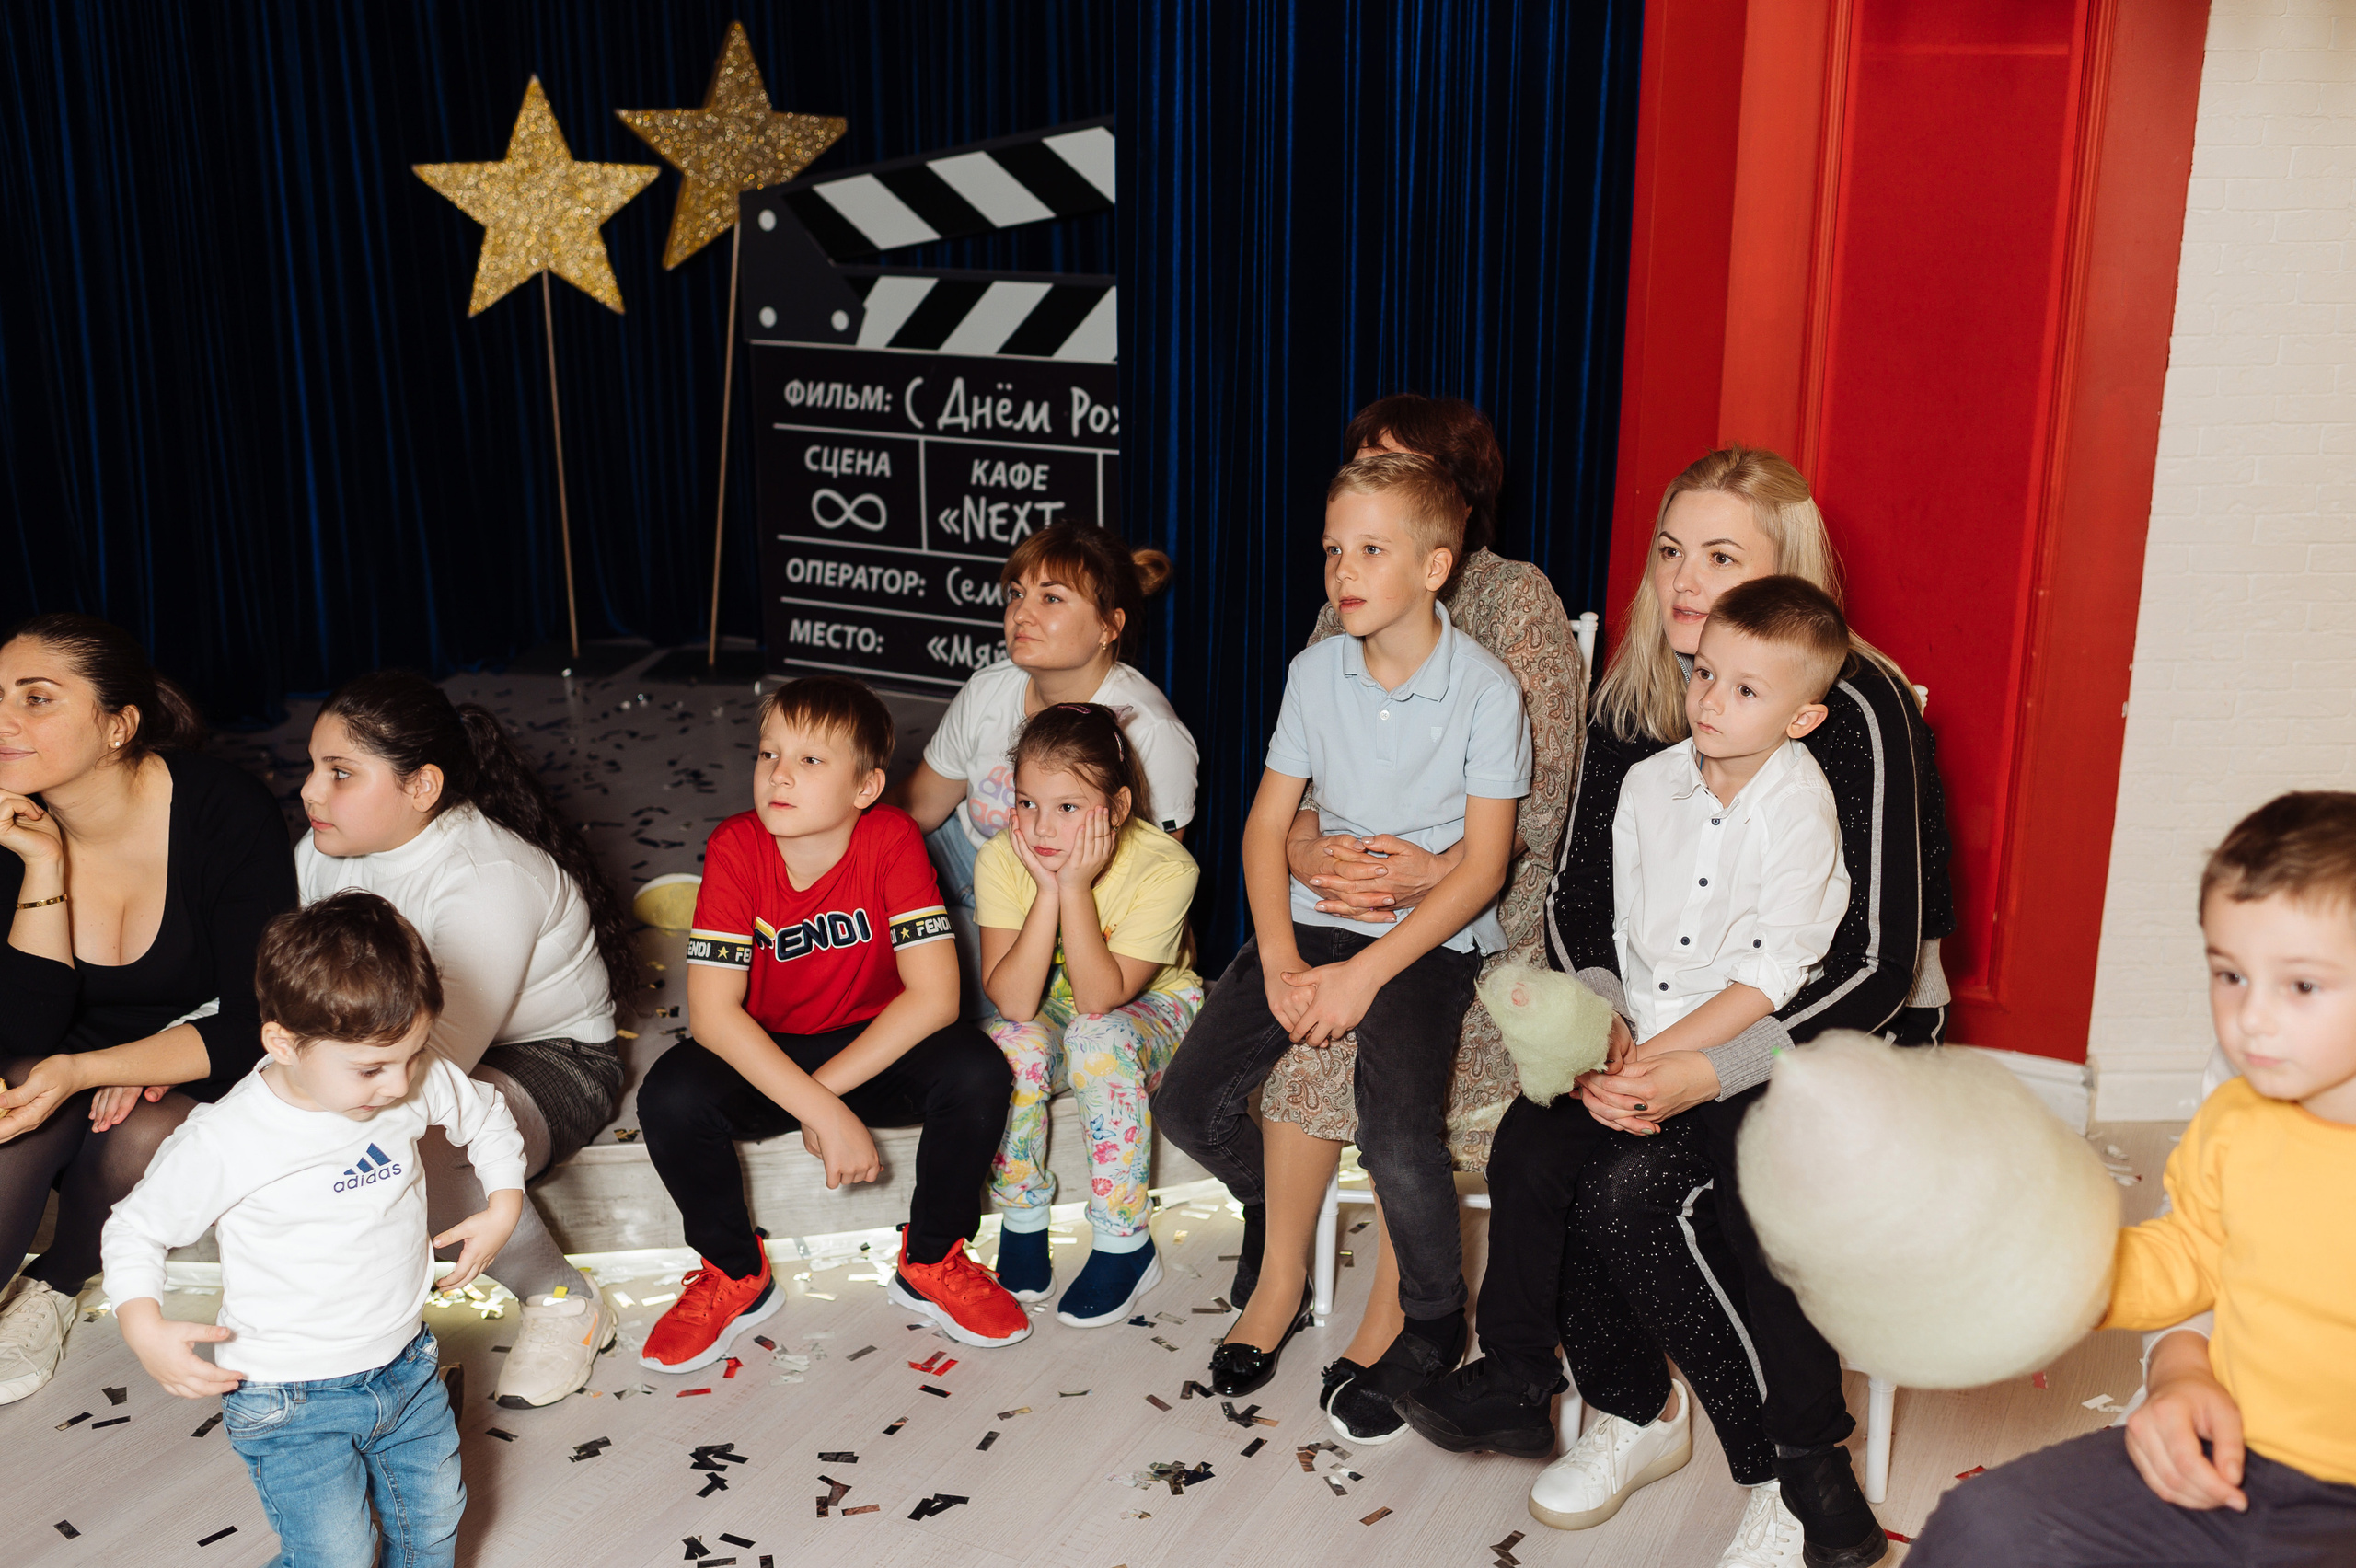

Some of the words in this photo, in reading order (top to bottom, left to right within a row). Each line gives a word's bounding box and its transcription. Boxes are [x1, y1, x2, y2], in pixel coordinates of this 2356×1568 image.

[784, 379, 893, 412] ФИЛЬМ:
[937, 376, 1052, 433] Днём
[804, 445, 891, 478] СЦЕНА
[970, 459, 1050, 491] КАФЕ
[786, 557, 926, 598] ОПЕРАТОР:
[946, 566, 1011, 606] Сем
[789, 618, 884, 654] МЕСТО:
[687, 940, 711, 958] ENDI
[333, 1163, 402, 1193] adidas
